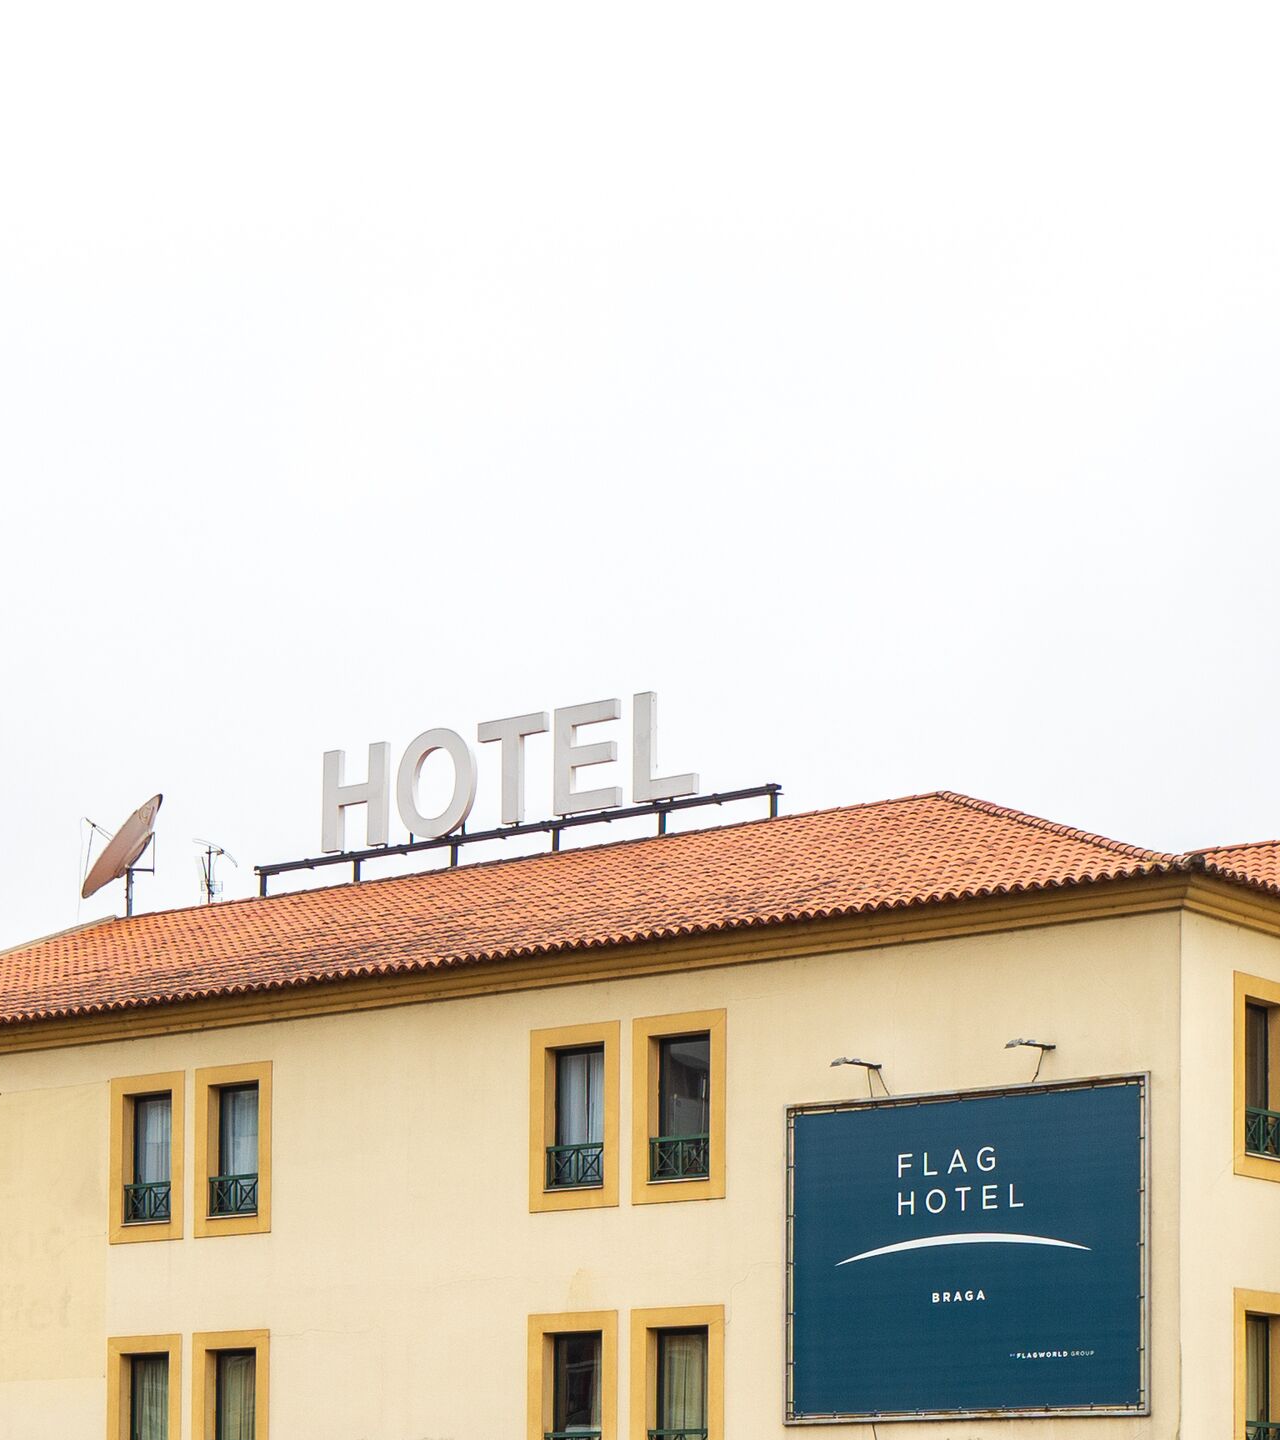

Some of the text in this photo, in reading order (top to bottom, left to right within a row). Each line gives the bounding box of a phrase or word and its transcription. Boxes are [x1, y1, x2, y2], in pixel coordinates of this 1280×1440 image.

[321, 690, 700, 854] HOTEL
[897, 1146, 997, 1179] FLAG
[897, 1183, 1025, 1216] HOTEL
[931, 1289, 986, 1303] BRAGA
[1016, 1350, 1069, 1359] FLAGWORLD
